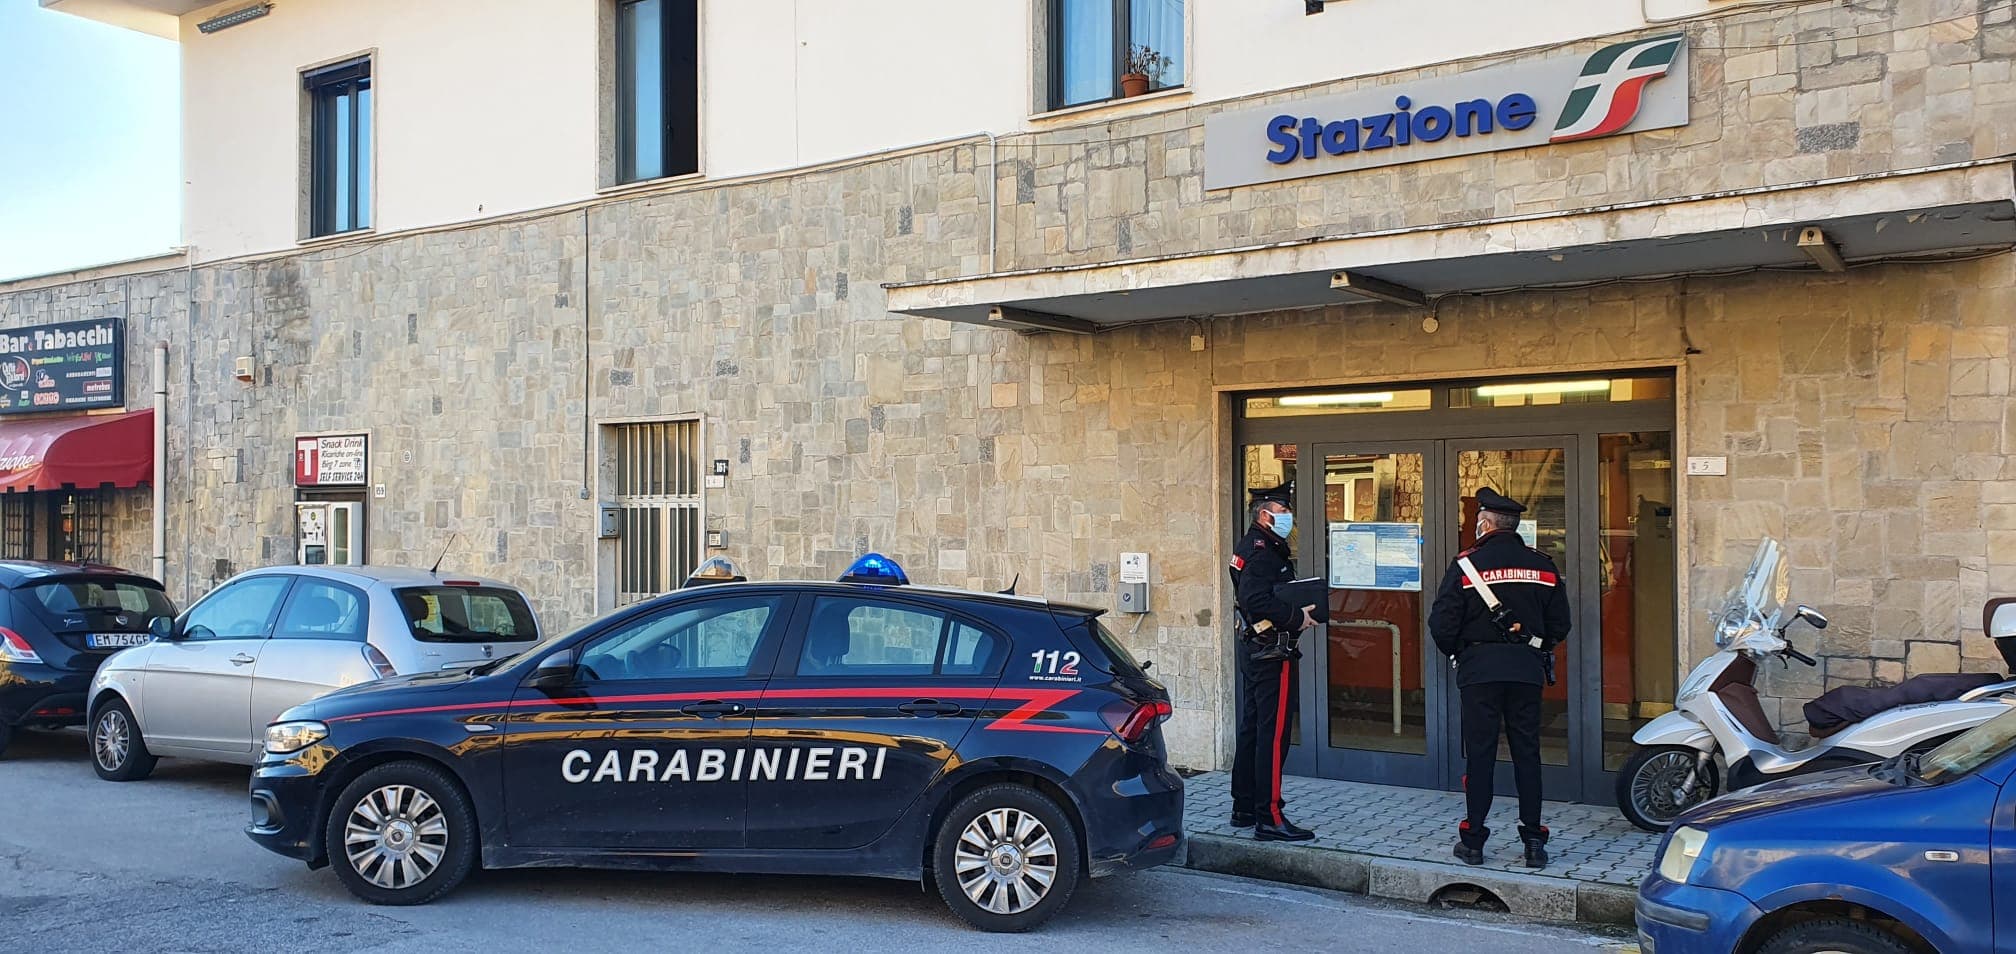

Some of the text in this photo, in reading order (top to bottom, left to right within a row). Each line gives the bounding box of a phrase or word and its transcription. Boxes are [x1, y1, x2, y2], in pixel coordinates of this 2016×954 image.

[1265, 92, 1537, 165] Stazione
[0, 323, 113, 353] Bar Tabacchi
[321, 438, 363, 449] Snack Drink
[319, 472, 332, 482] SELF
[332, 471, 353, 481] SERVICE
[1482, 568, 1540, 581] CARABINIERI
[1031, 649, 1081, 675] 112
[561, 747, 887, 782] CARABINIERI
